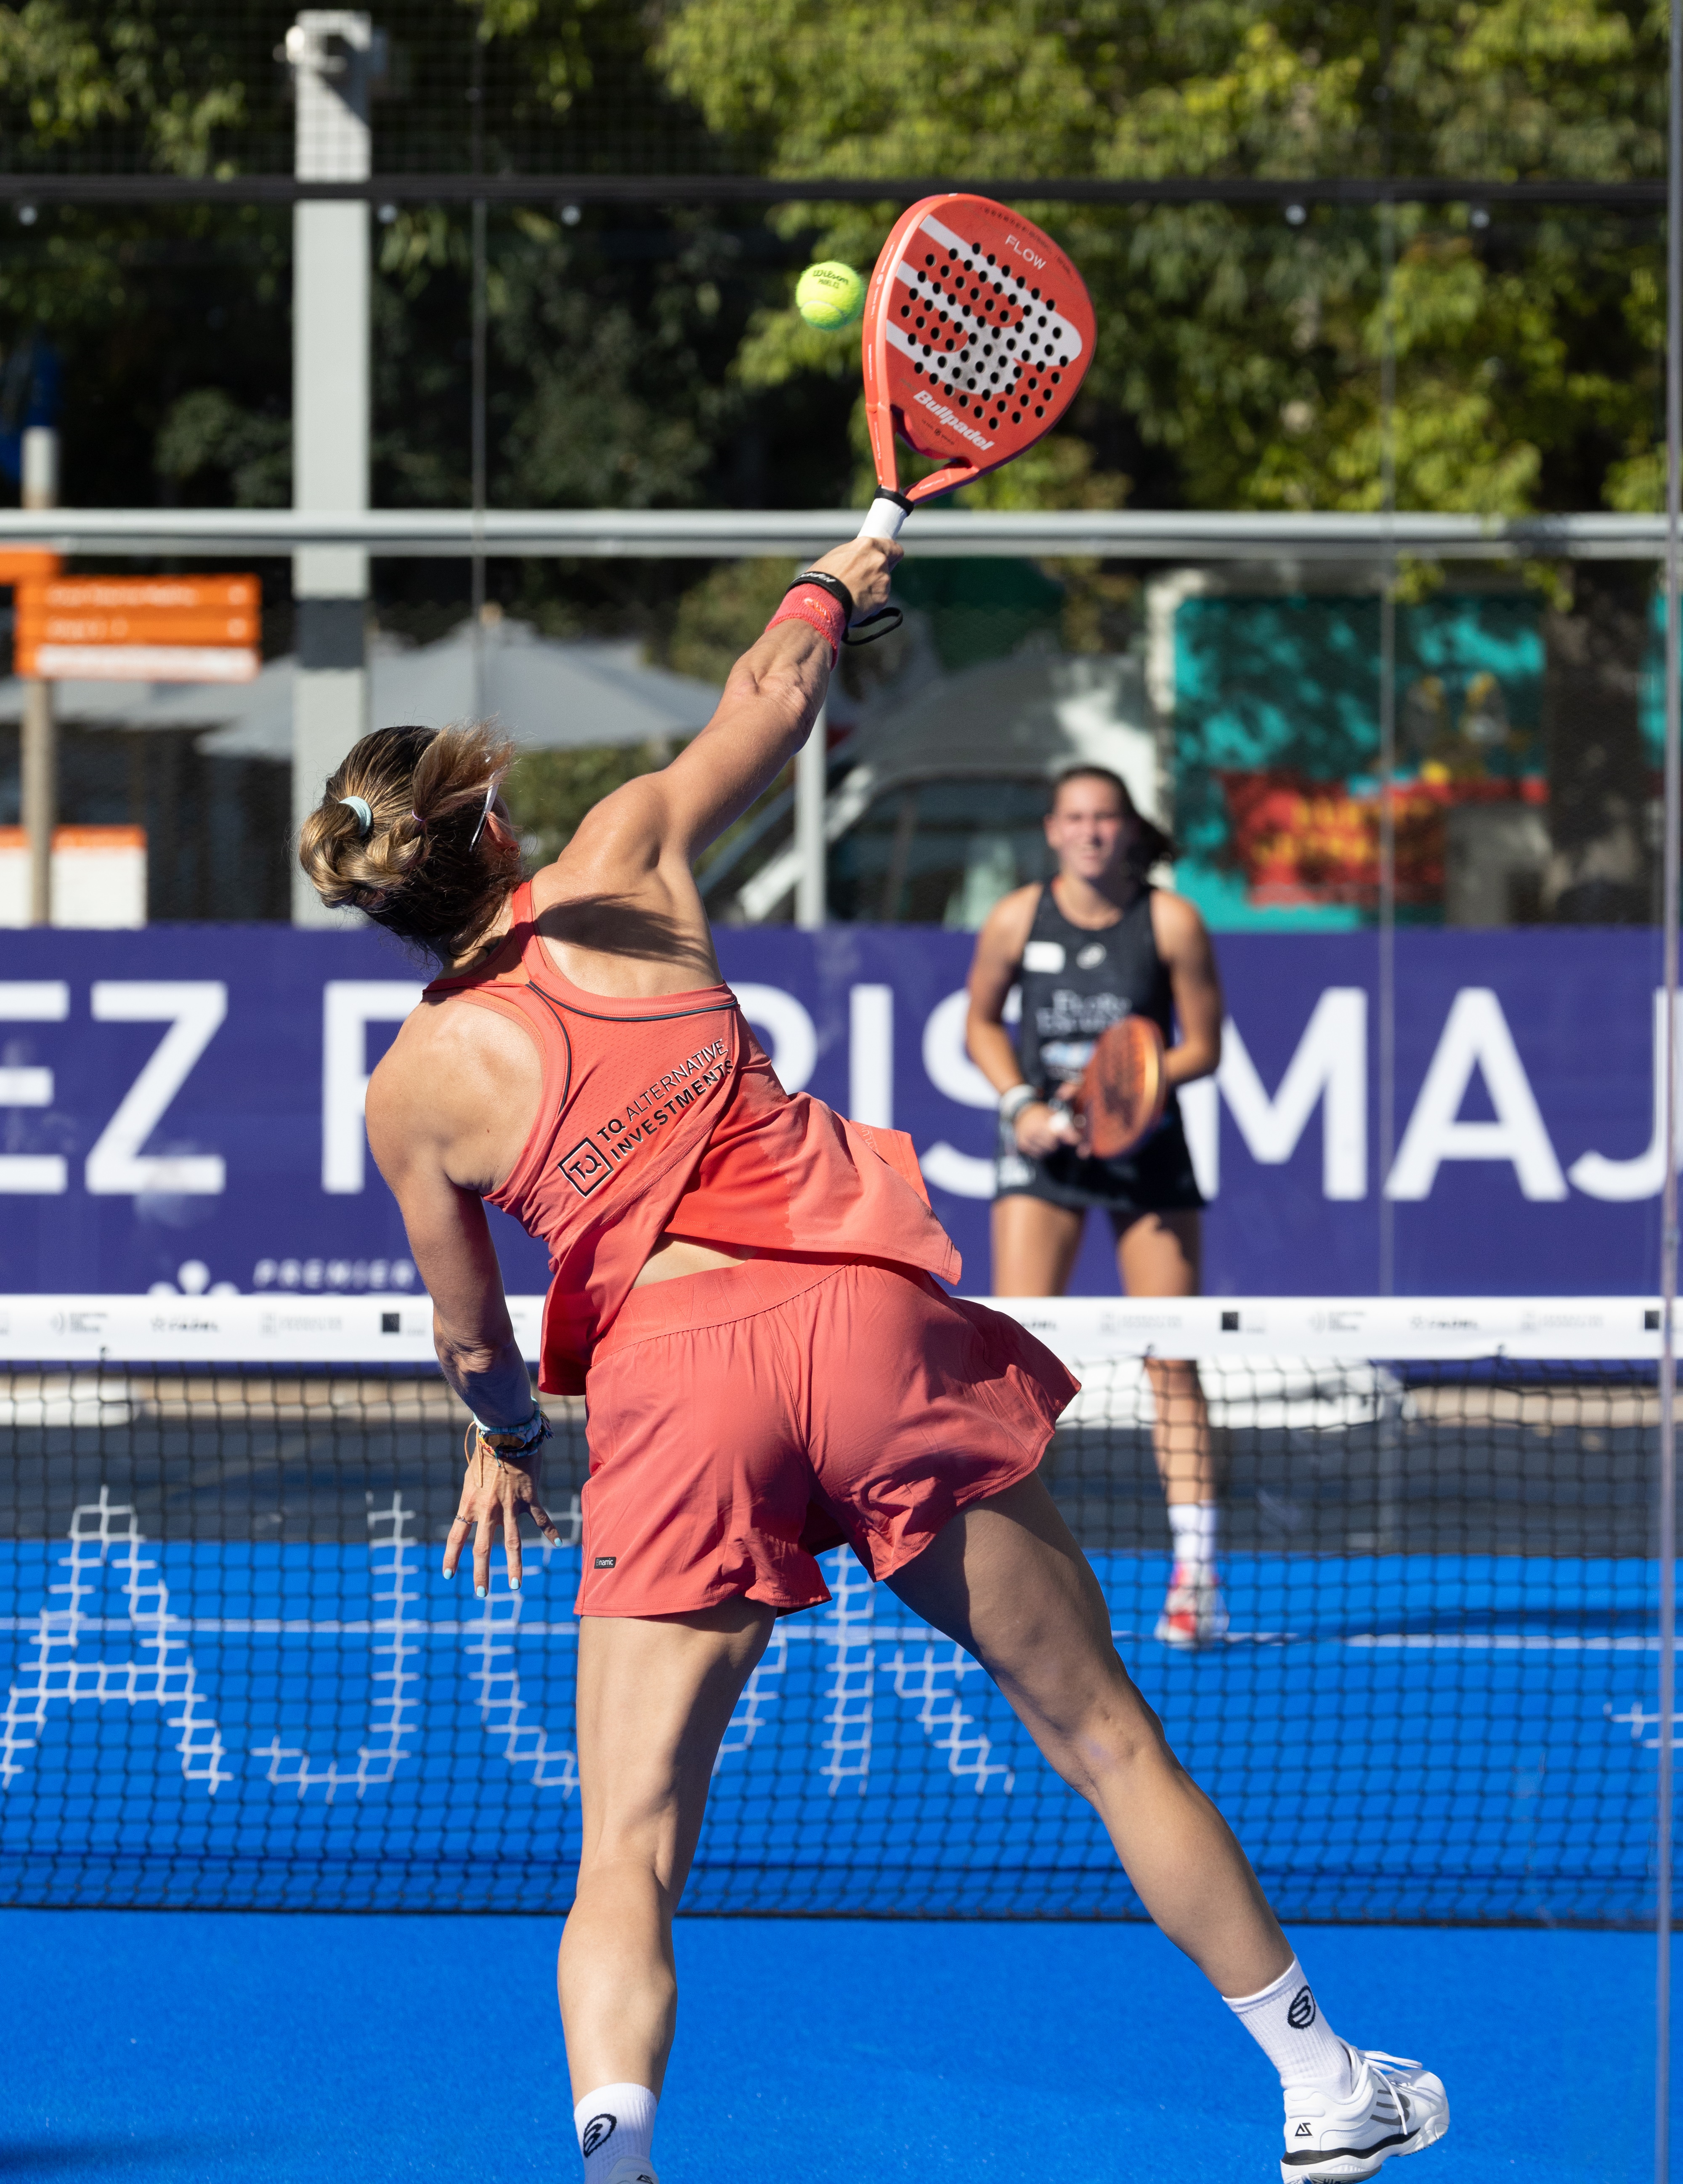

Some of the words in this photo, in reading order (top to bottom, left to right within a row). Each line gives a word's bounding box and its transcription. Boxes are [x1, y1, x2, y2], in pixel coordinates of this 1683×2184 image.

[812, 270, 849, 285] Wilson
[1005, 234, 1046, 270] FLOW
[913, 390, 995, 451] Bullpadel
[597, 1118, 626, 1142] TQ
[626, 1039, 728, 1122] ALTERNATIVE
[610, 1060, 733, 1162] INVESTMENTS
